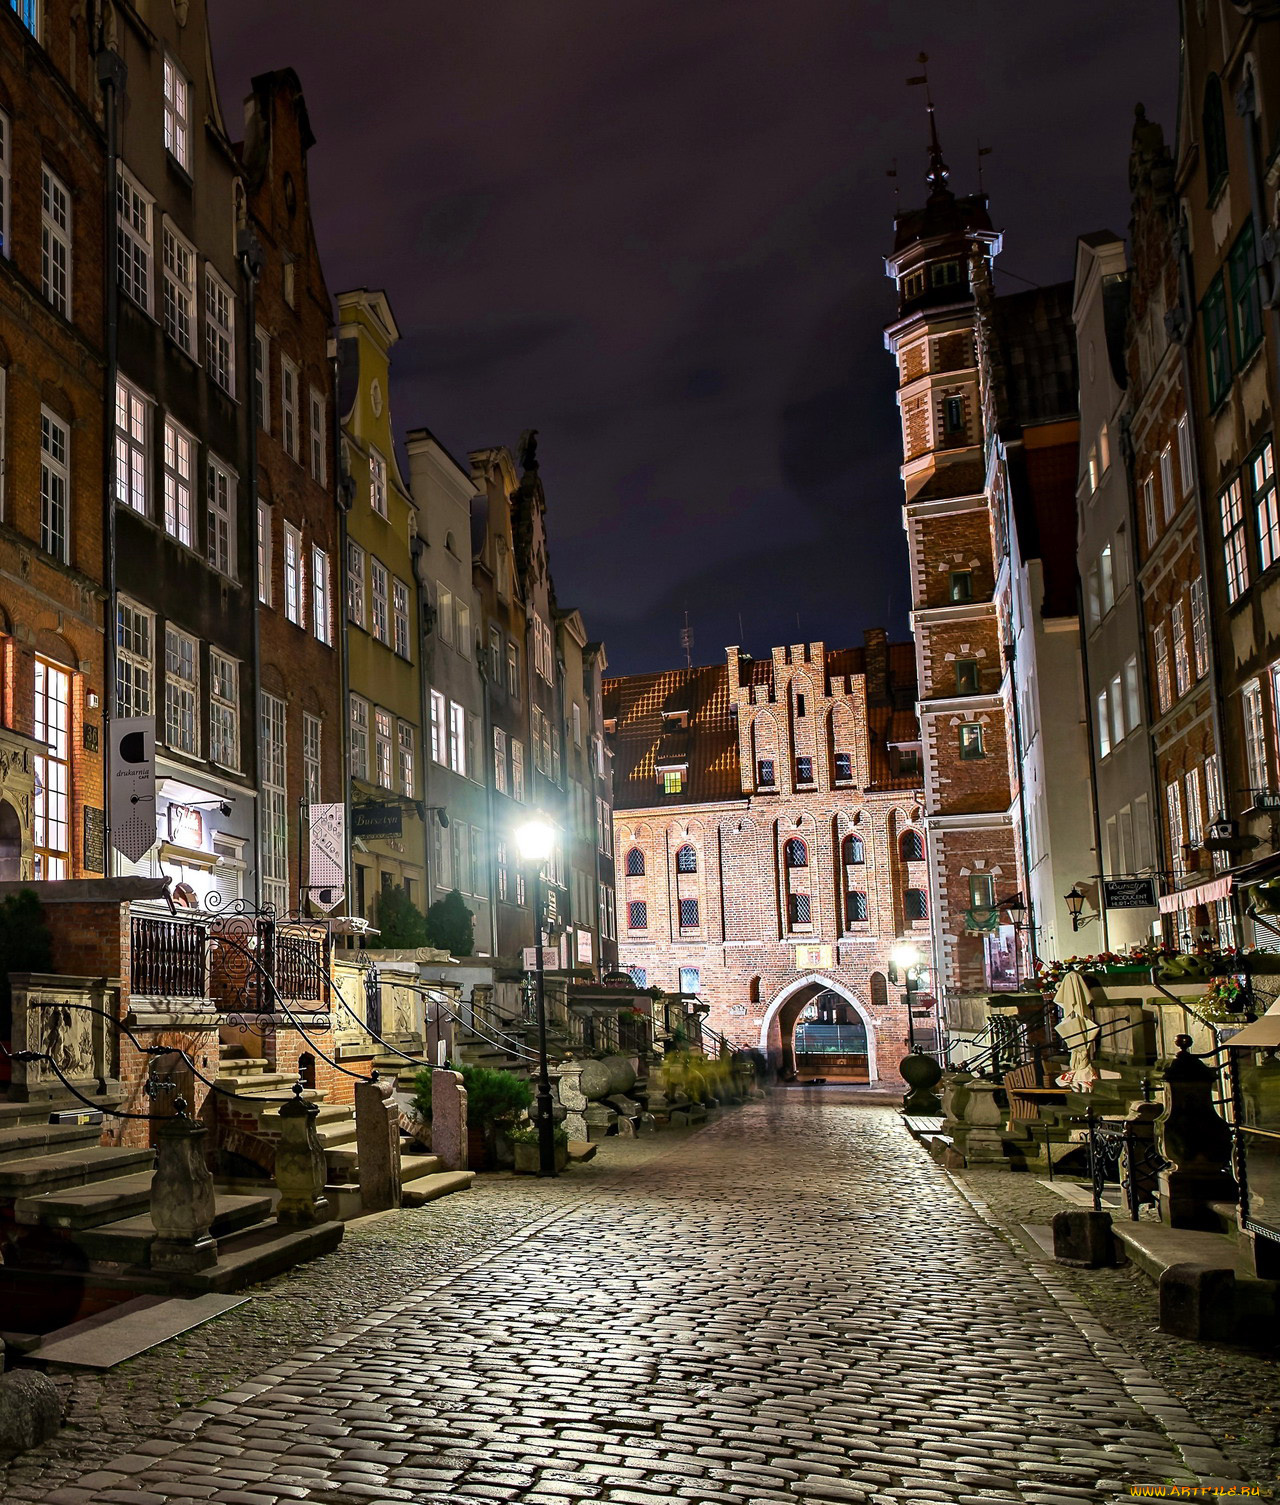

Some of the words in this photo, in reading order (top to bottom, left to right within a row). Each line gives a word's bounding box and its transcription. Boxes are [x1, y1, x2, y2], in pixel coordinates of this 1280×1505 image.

[87, 727, 98, 743] 36
[116, 769, 149, 777] drukarnia
[356, 815, 398, 826] Bursztyn
